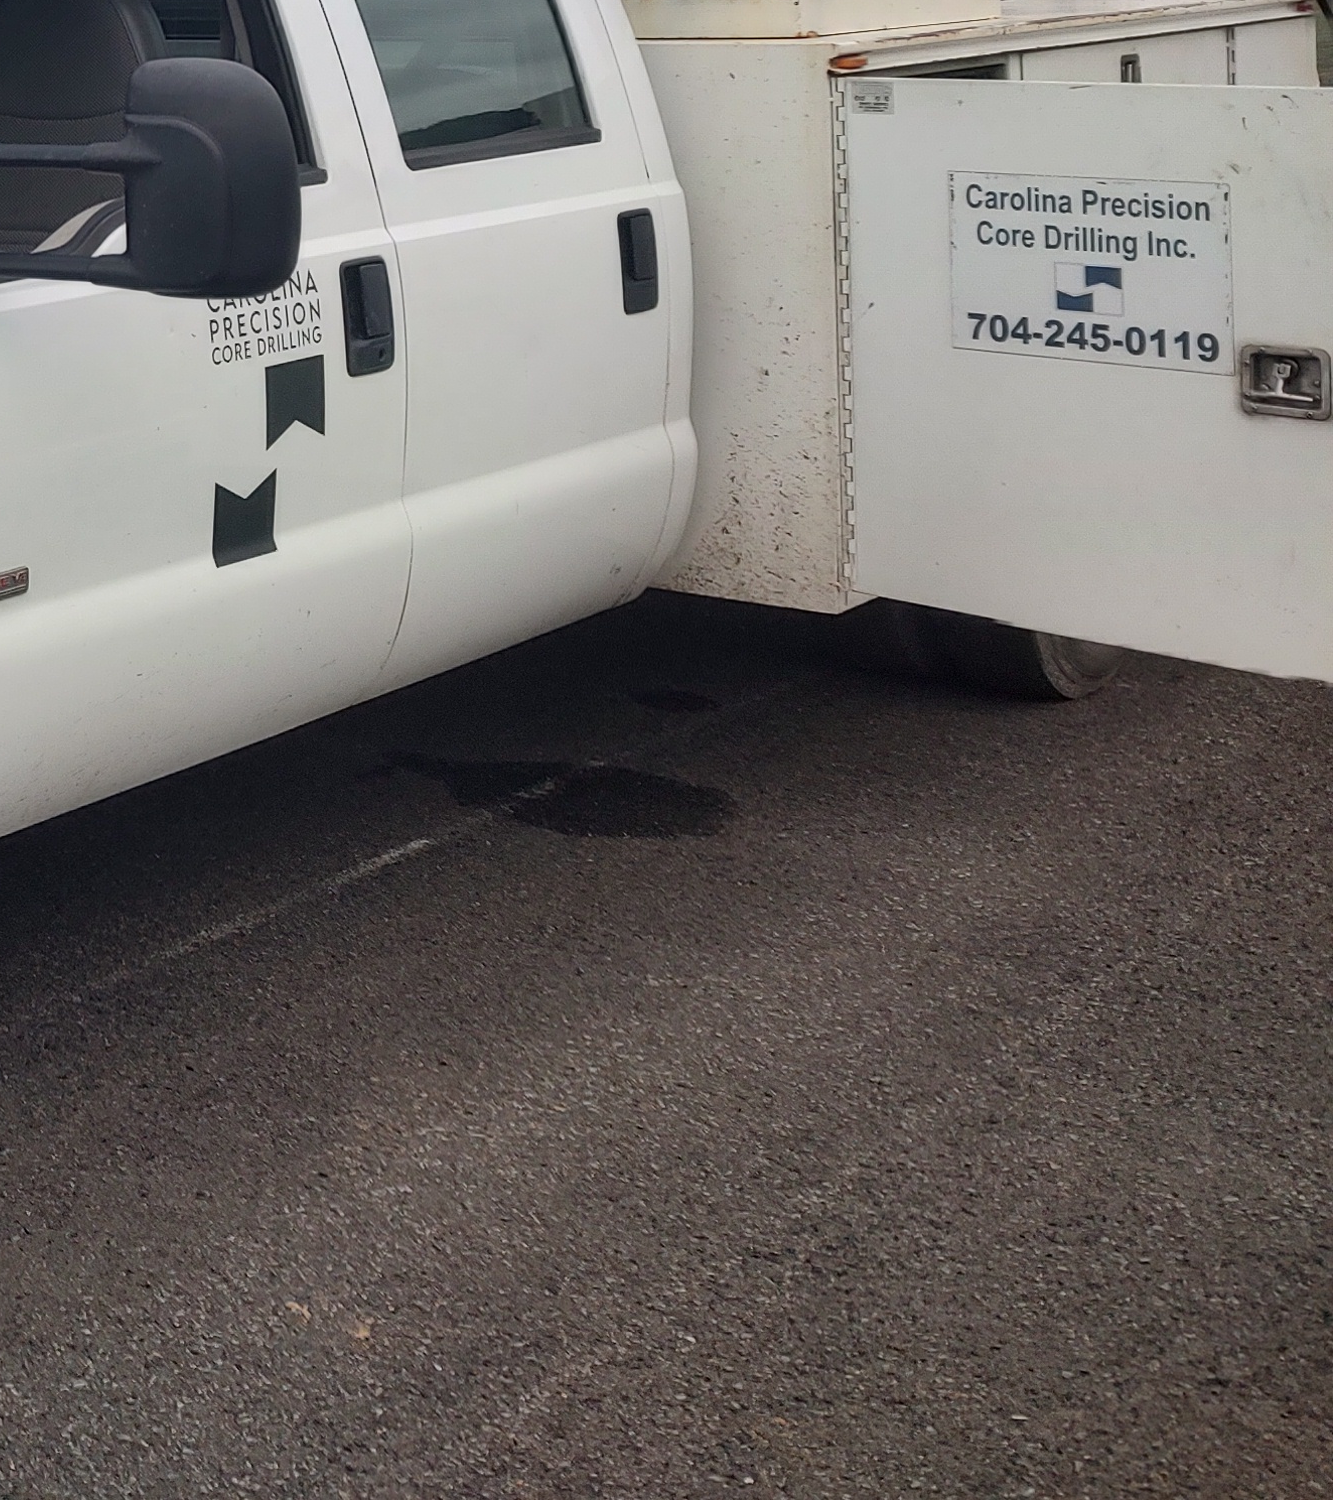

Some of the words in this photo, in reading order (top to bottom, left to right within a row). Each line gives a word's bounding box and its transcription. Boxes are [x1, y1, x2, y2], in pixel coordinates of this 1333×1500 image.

[965, 183, 1073, 215] Carolina
[1081, 189, 1212, 222] Precision
[976, 220, 1036, 249] Core
[1043, 224, 1138, 261] Drilling
[1147, 231, 1197, 259] Inc.
[209, 298, 321, 343] PRECISION
[967, 312, 1221, 363] 704-245-0119
[212, 340, 251, 366] CORE
[257, 326, 322, 356] DRILLING
